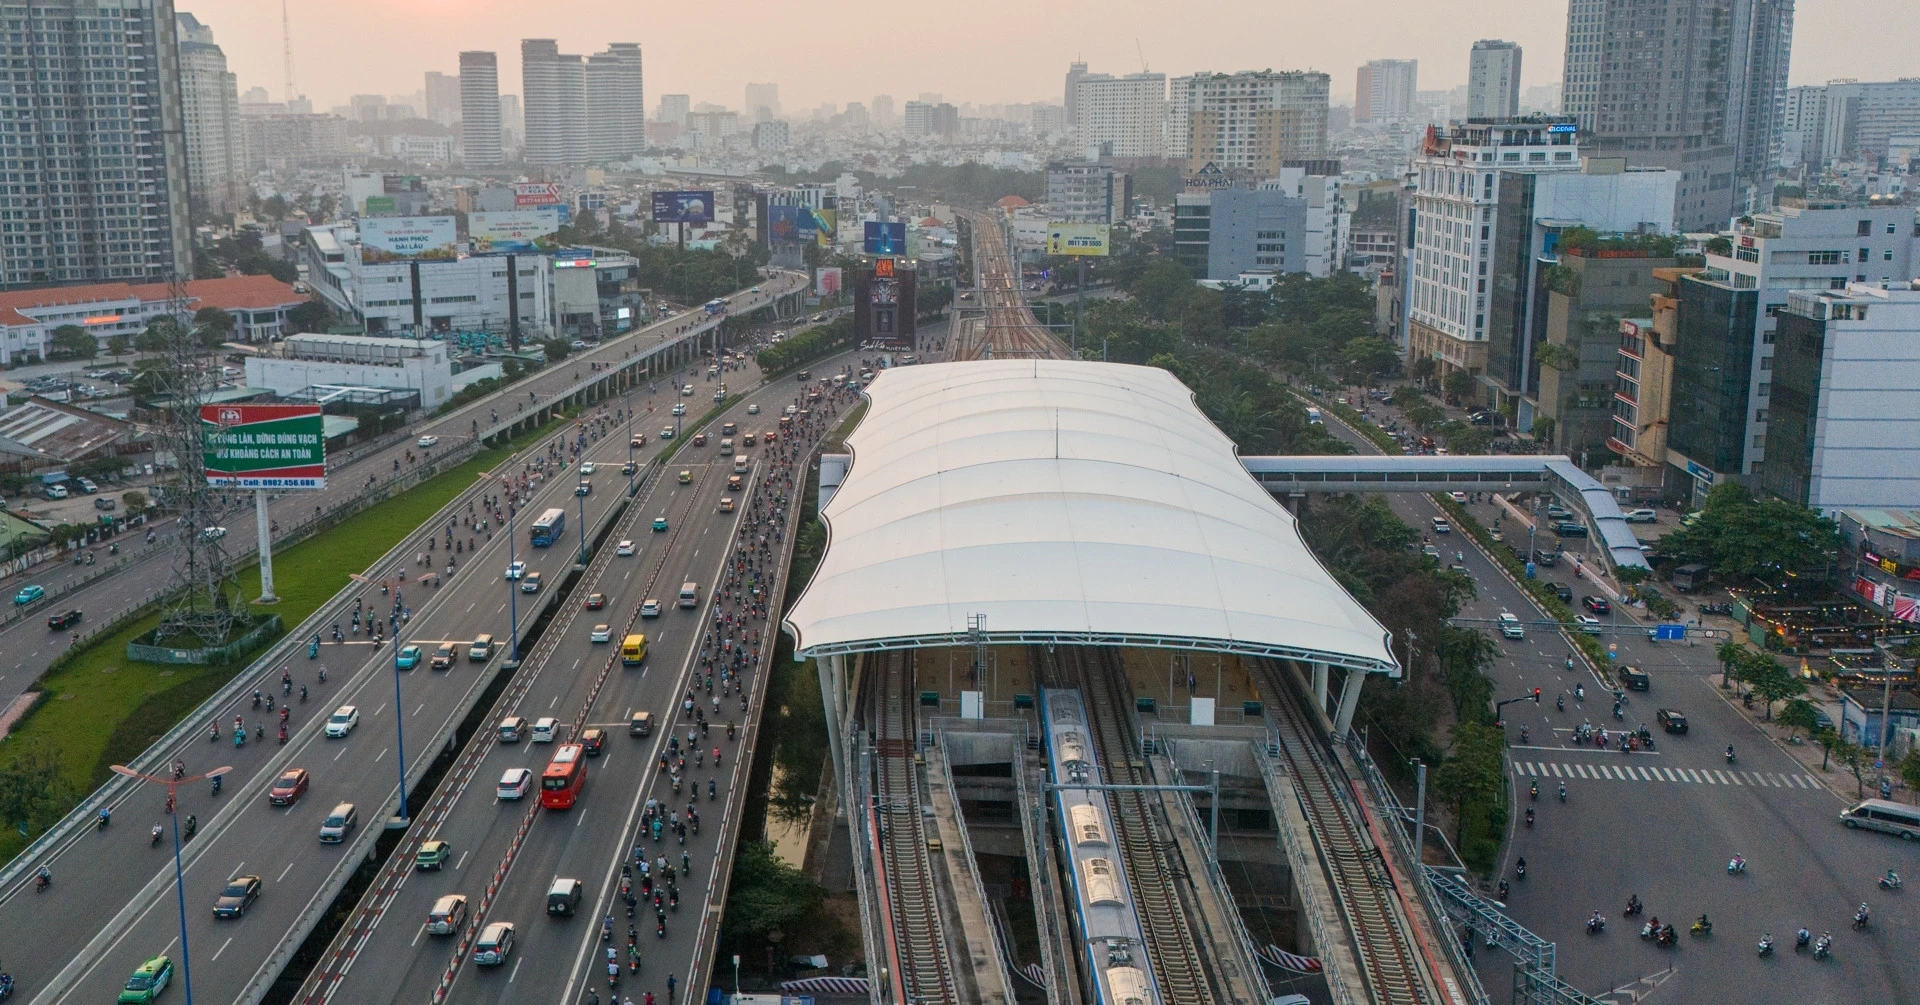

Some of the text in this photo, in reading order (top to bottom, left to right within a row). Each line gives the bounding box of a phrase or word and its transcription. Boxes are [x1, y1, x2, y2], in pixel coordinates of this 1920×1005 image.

[230, 446, 259, 459] KHOẢNG
[260, 447, 279, 459] CÁCH
[281, 449, 291, 459] AN
[292, 447, 311, 459] TOÀN
